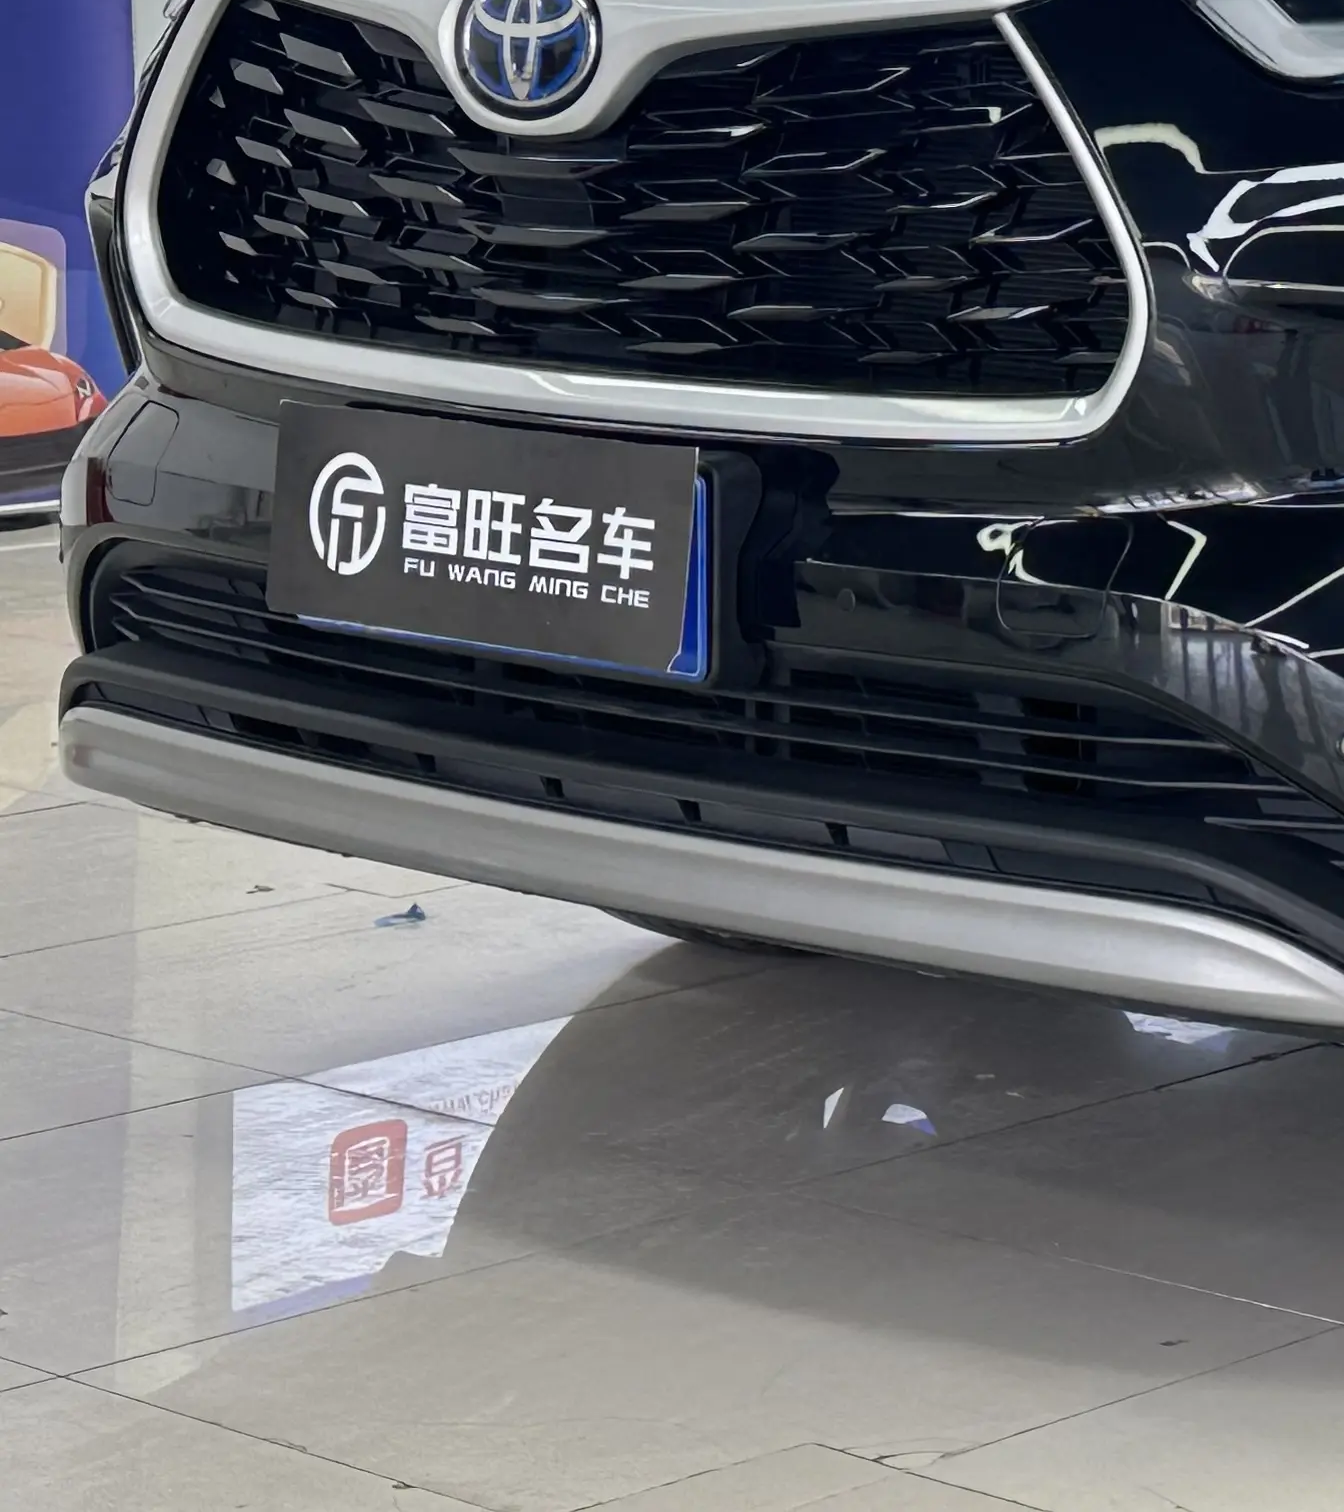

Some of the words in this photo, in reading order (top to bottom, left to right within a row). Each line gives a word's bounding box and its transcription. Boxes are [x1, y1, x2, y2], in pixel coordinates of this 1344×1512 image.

[402, 483, 655, 579] 富旺名车
[403, 557, 436, 577] FU
[448, 563, 517, 590] WANG
[528, 574, 589, 600] MING
[601, 584, 651, 609] CHE
